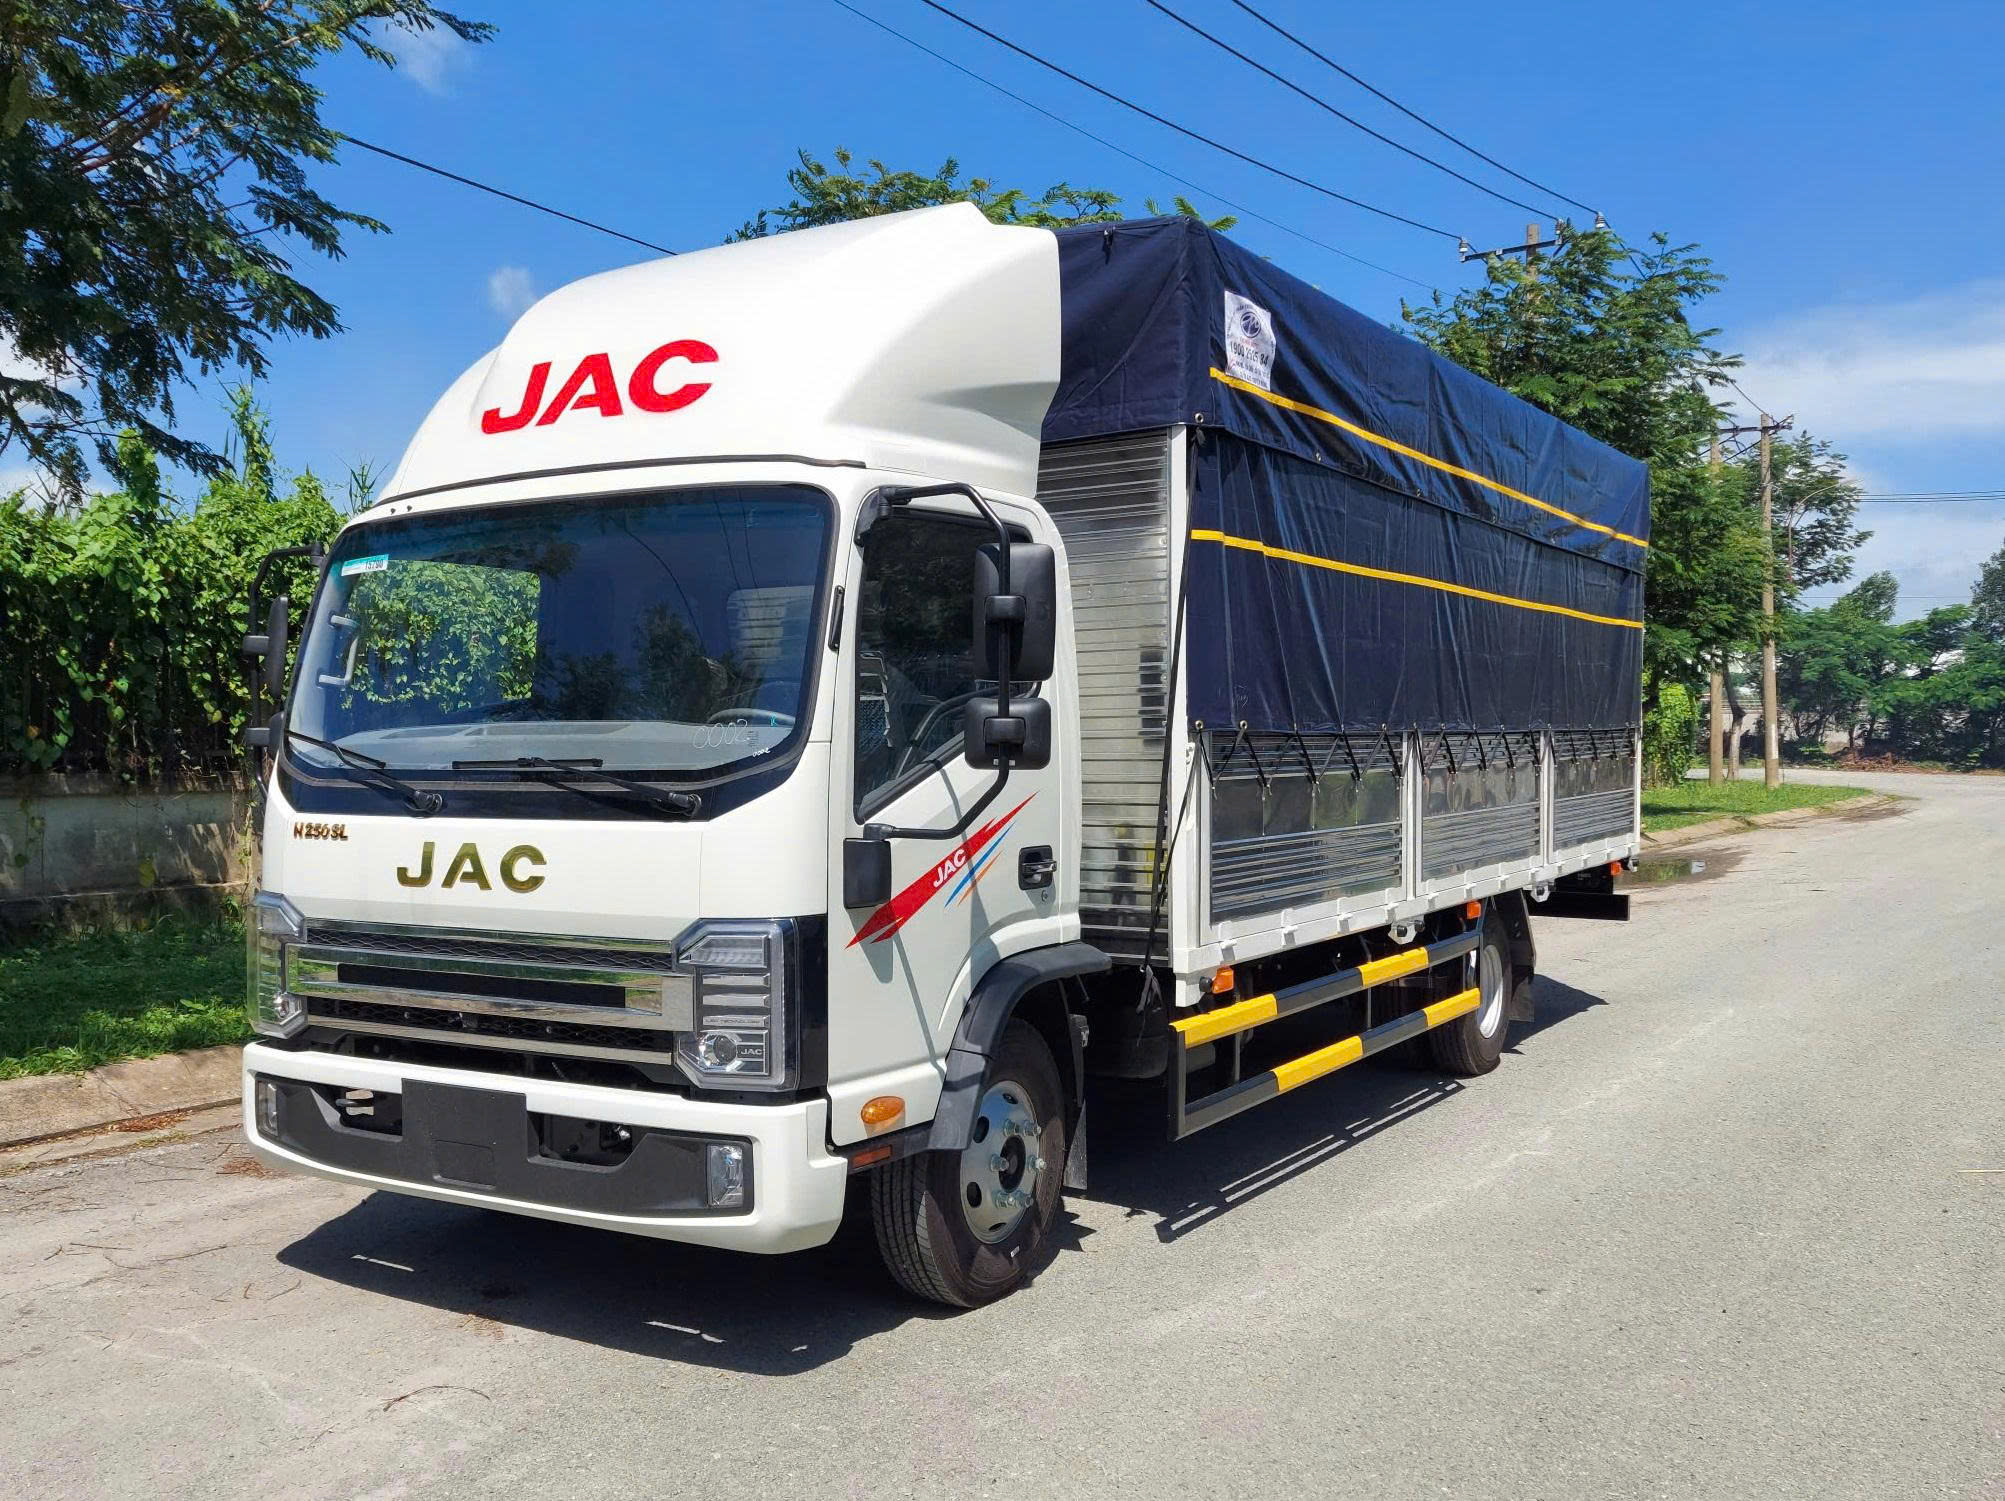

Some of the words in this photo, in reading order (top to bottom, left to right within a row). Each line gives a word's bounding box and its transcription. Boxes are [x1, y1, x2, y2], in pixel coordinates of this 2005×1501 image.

[481, 339, 720, 435] JAC
[396, 841, 547, 894] JAC
[933, 849, 967, 888] JAC
[740, 1048, 763, 1056] JAC
